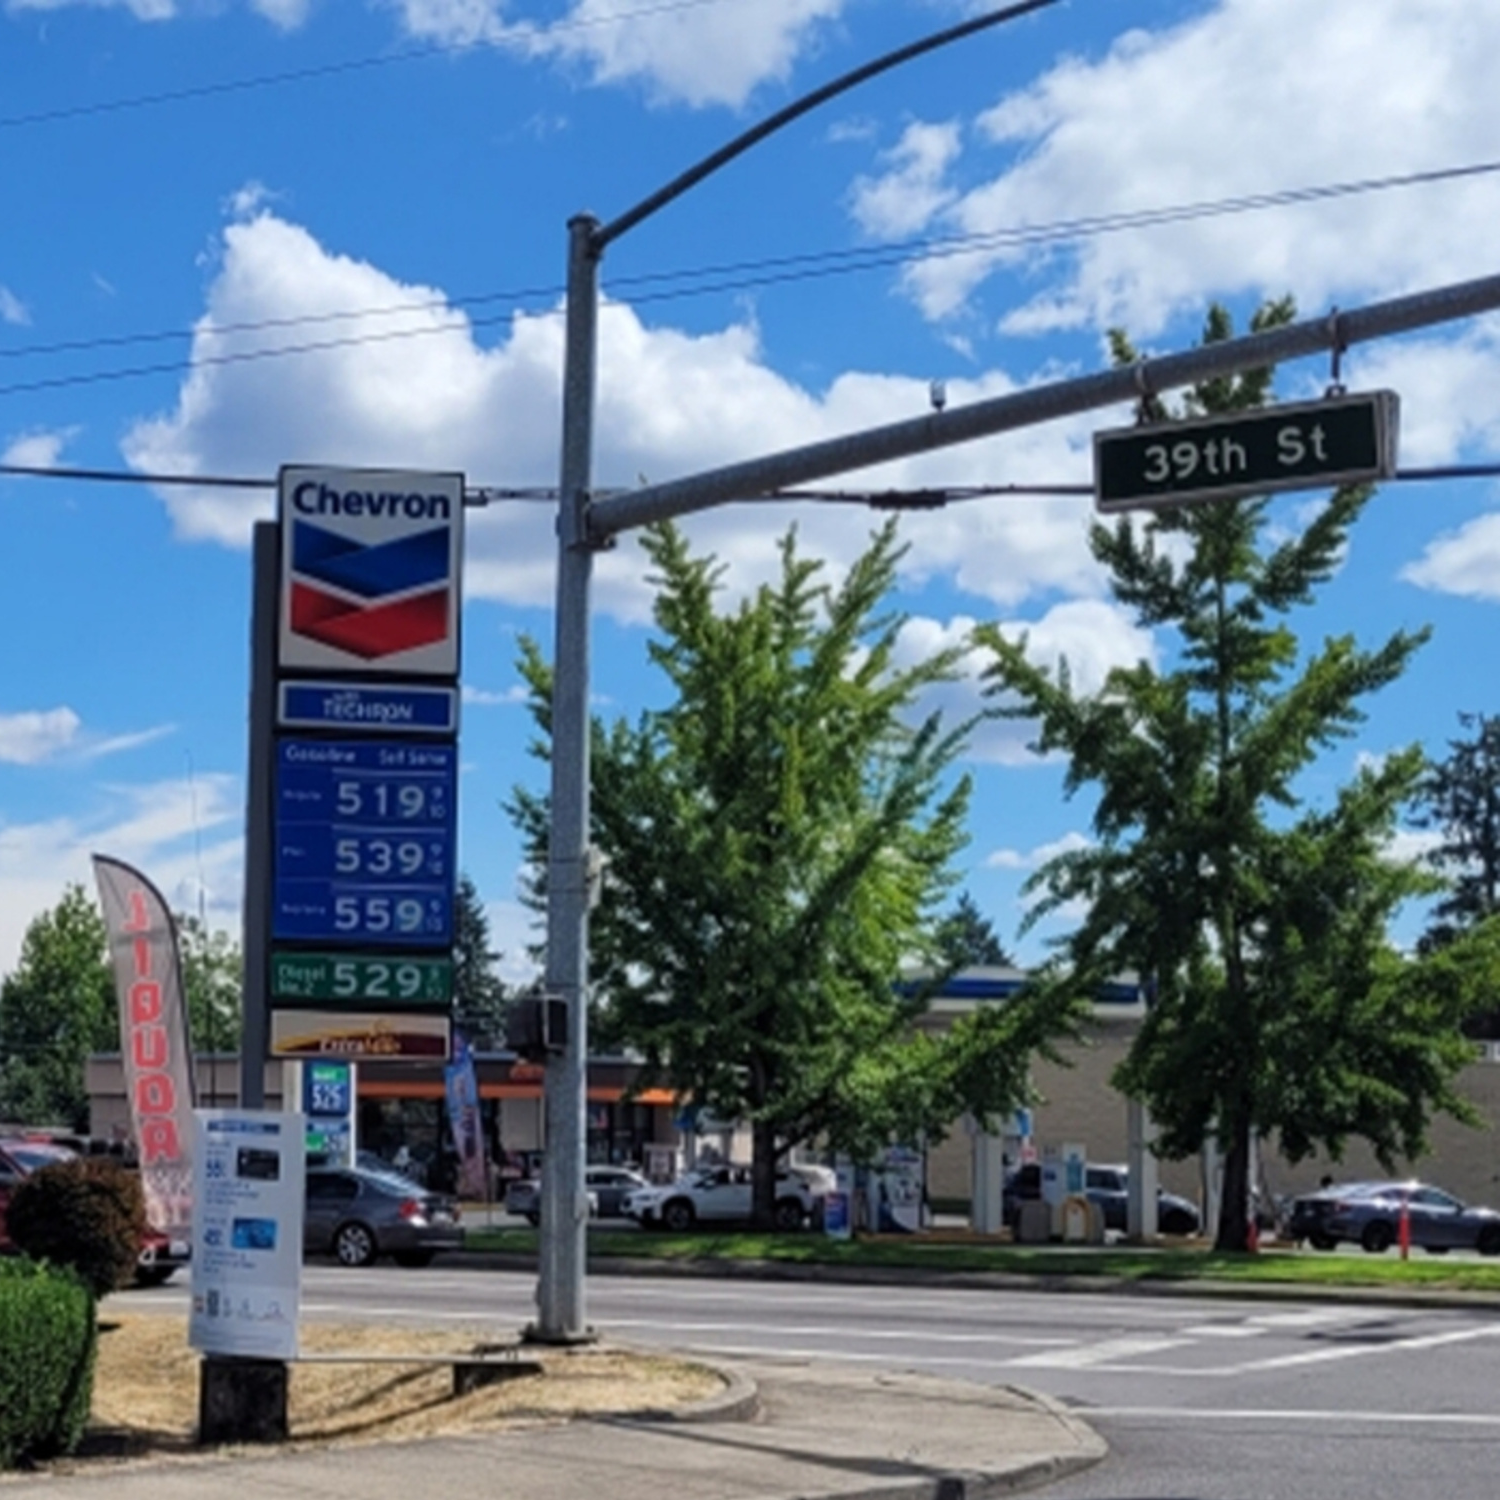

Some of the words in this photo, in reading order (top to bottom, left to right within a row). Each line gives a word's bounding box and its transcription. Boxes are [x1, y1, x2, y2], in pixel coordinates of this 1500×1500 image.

[1142, 438, 1247, 483] 39th
[1276, 423, 1329, 466] St
[292, 481, 450, 519] Chevron
[336, 782, 425, 818] 519
[335, 839, 424, 875] 539
[334, 897, 423, 932] 559
[333, 962, 421, 997] 529
